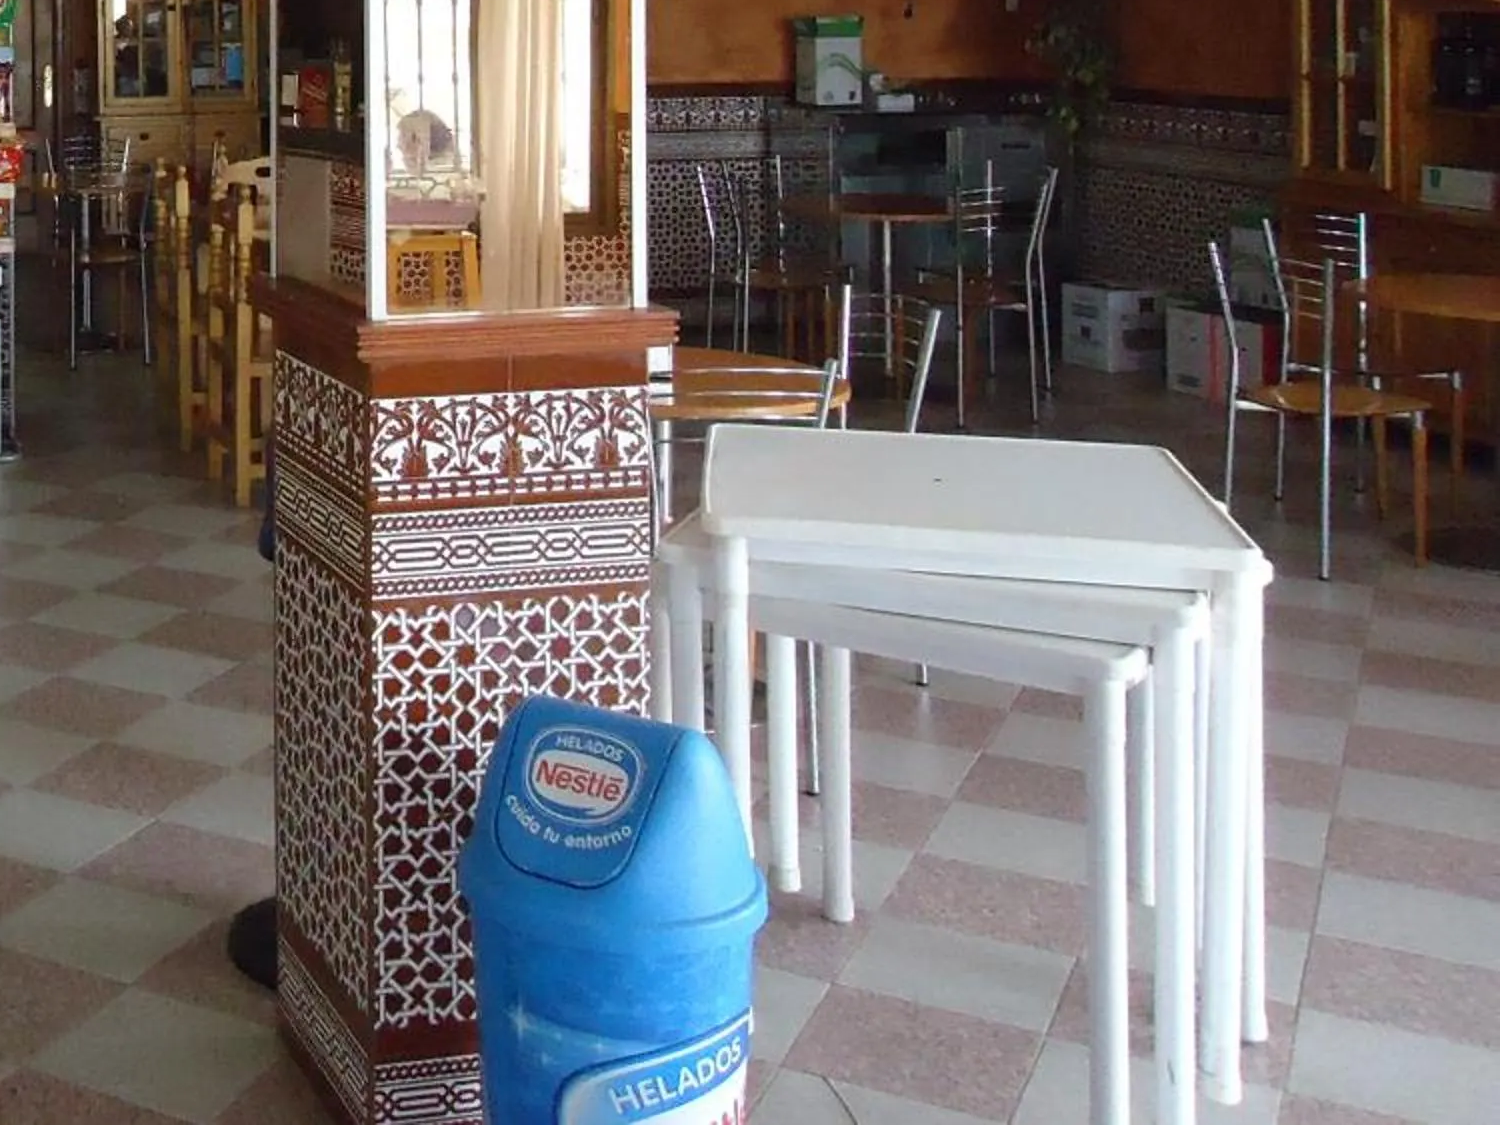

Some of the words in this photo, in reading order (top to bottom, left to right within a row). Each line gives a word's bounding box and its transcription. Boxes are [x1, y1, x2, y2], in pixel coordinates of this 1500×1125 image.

[555, 735, 625, 762] HELADOS
[506, 794, 541, 835] cuida
[543, 826, 560, 844] tu
[564, 825, 633, 849] entorno
[608, 1035, 742, 1115] HELADOS
